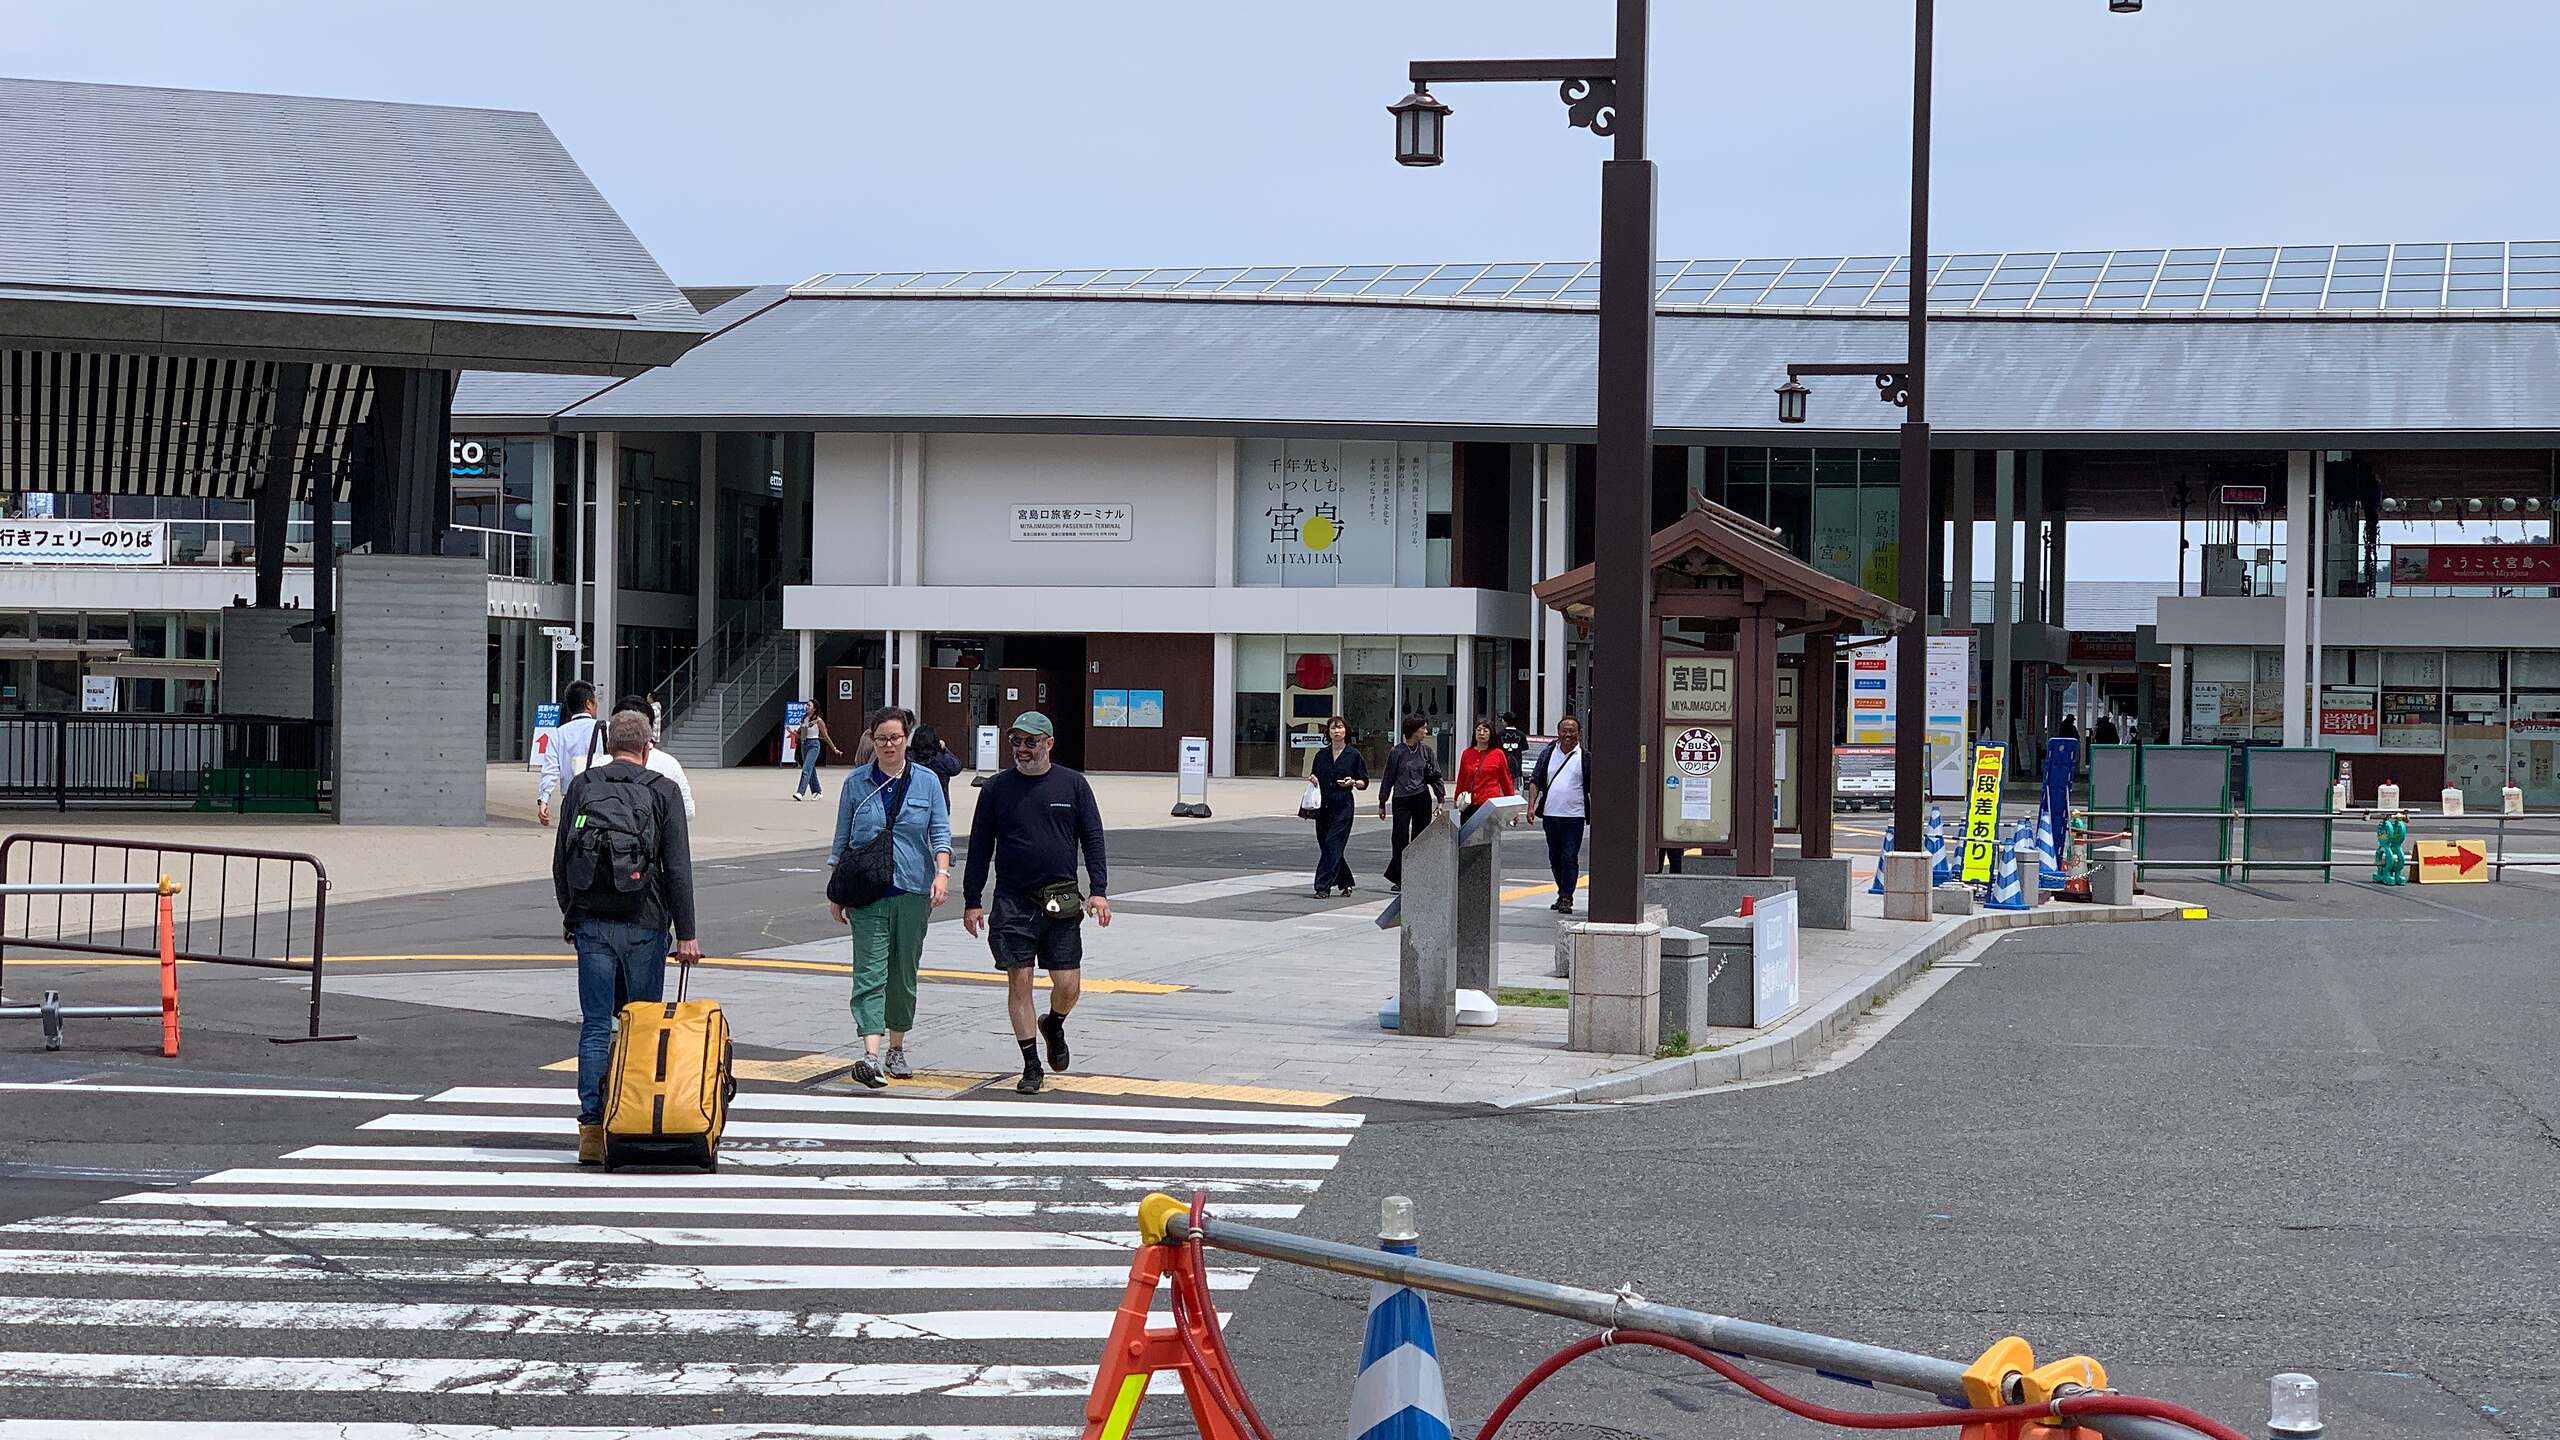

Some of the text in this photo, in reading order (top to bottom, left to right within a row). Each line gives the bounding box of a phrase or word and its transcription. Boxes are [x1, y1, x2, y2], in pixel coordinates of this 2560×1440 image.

[1268, 458, 1338, 472] 千年先も、
[1267, 478, 1345, 493] いつくしむ。
[1018, 509, 1125, 520] 宮島口旅客ターミナル
[0, 529, 153, 548] 行きフェリーのりば
[1266, 553, 1343, 565] MIYAJIMA
[2443, 556, 2551, 569] ようこそ宮島へ
[1672, 666, 1727, 692] 宮島口
[1671, 700, 1727, 712] MIYAJIMAGUCHI
[2324, 713, 2375, 730] 営業中
[1677, 729, 1719, 749] HEART
[1684, 761, 1710, 771] のりば
[1970, 775, 1997, 861] 段差あり
